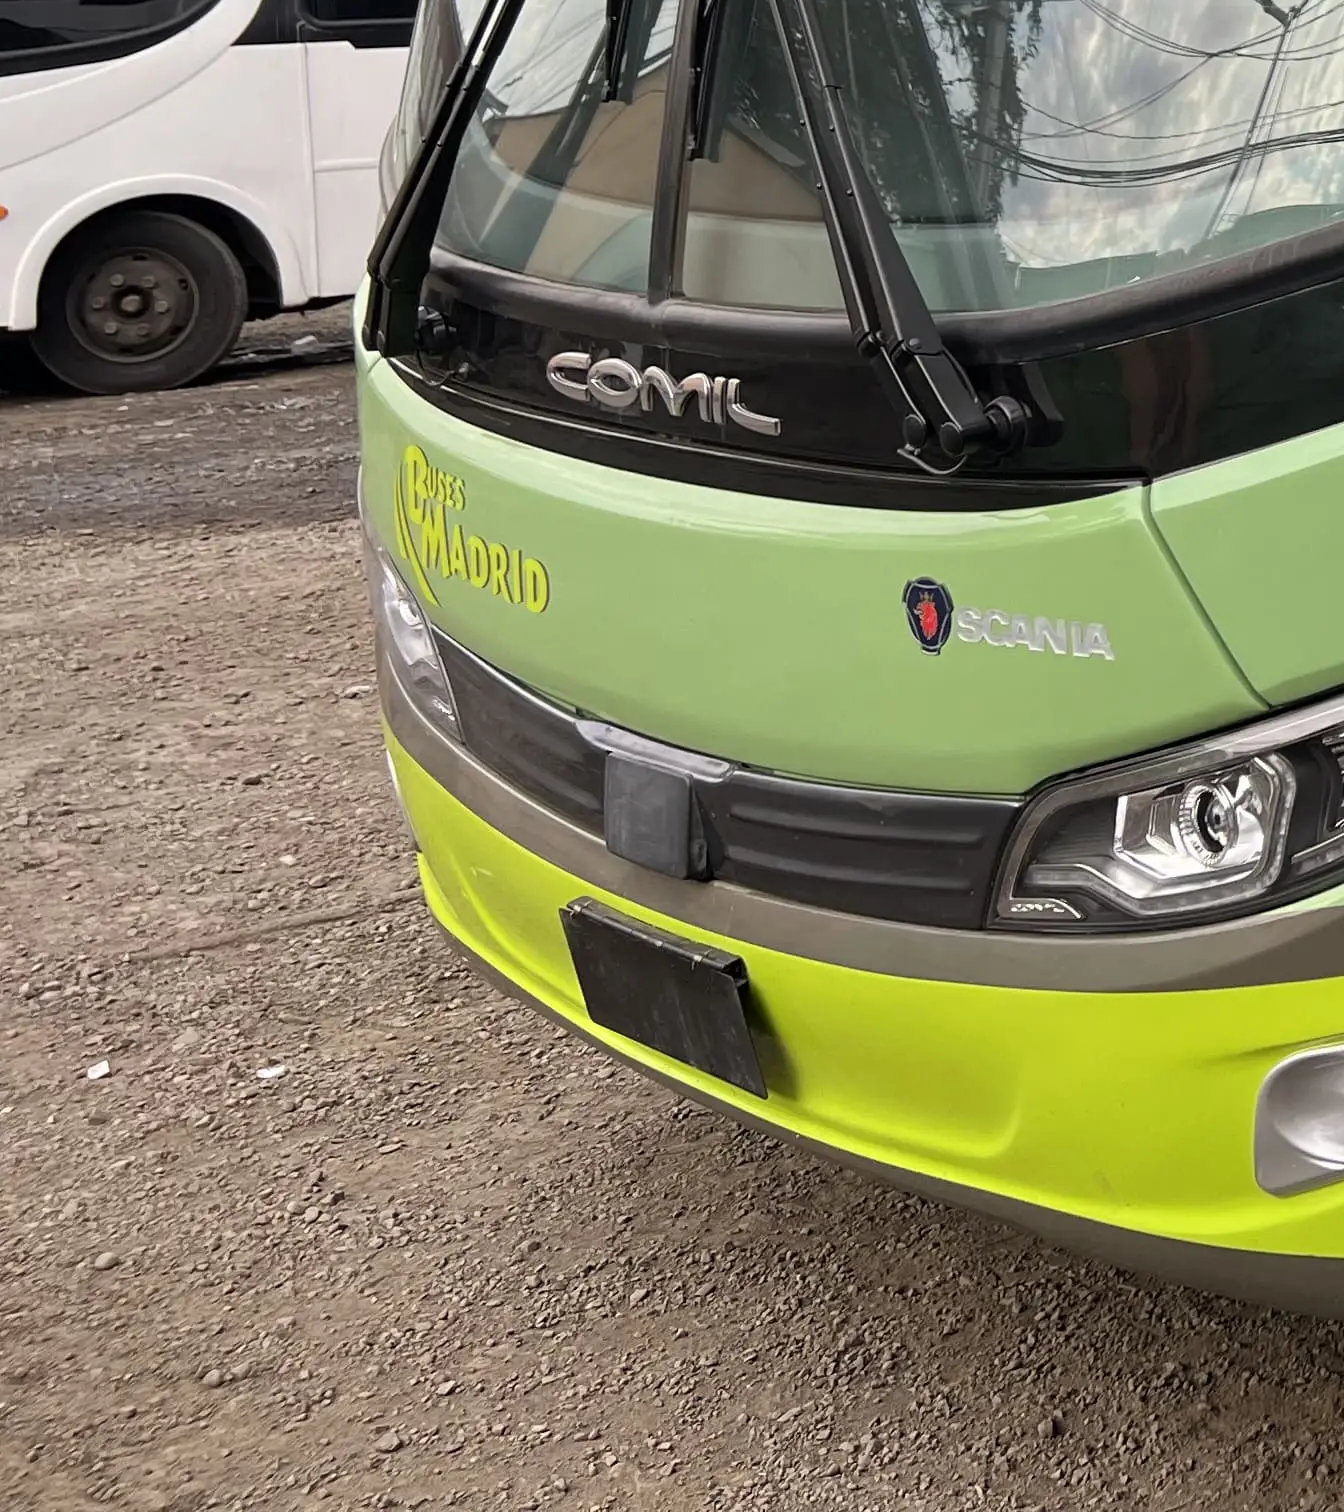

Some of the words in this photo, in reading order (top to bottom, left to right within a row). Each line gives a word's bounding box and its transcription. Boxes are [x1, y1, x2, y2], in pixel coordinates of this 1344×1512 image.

[546, 351, 782, 437] COMIL
[403, 444, 466, 525] BUSES
[420, 502, 550, 614] MADRID
[956, 606, 1116, 661] SCANIA
